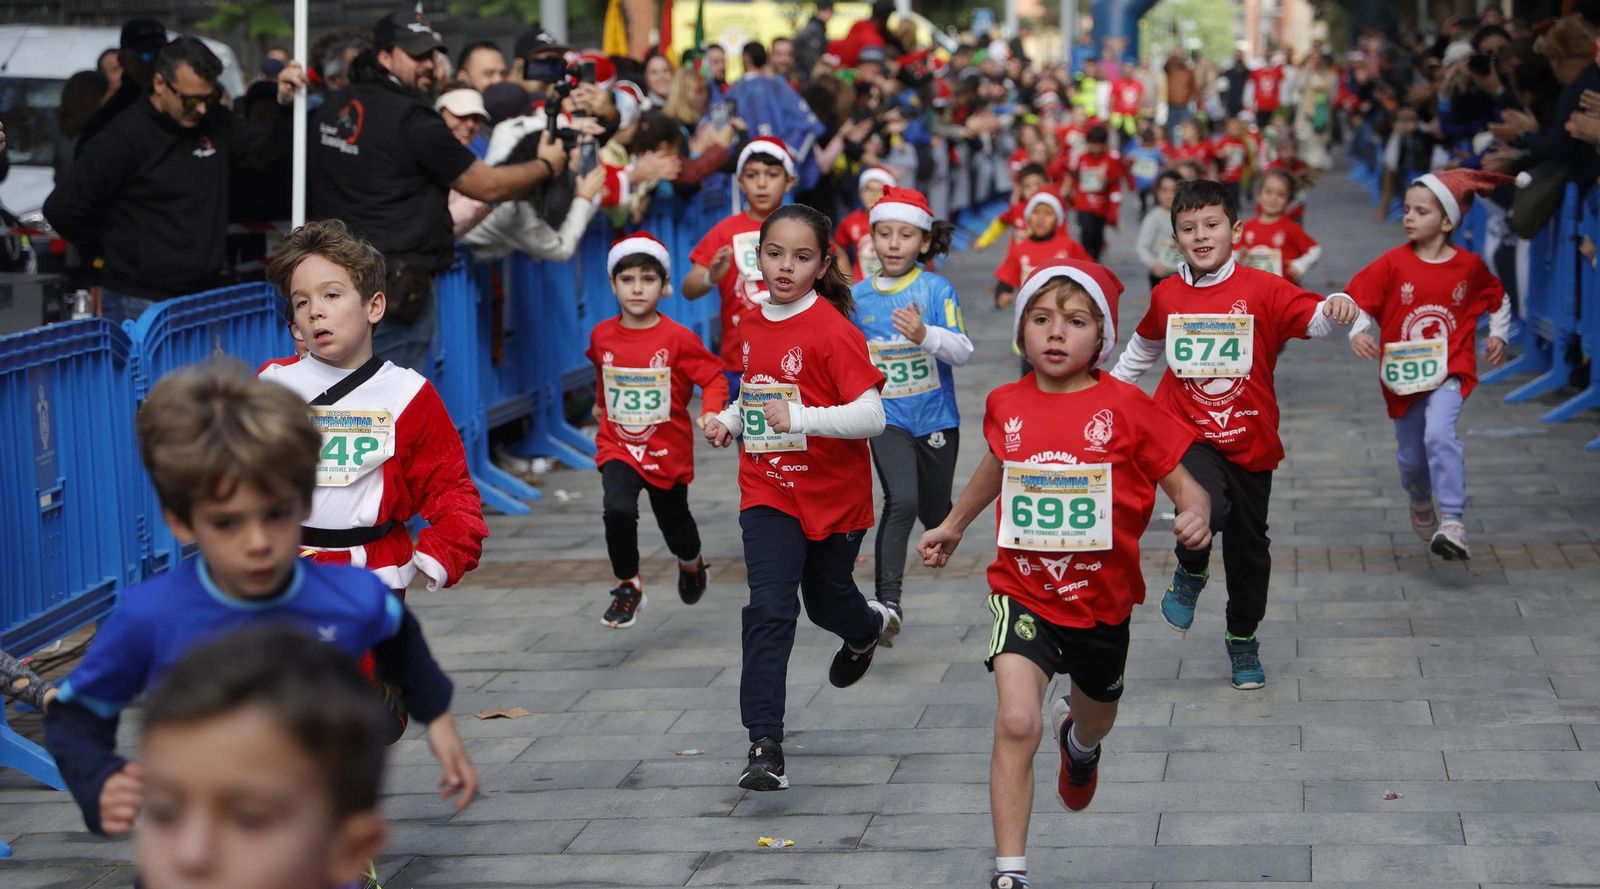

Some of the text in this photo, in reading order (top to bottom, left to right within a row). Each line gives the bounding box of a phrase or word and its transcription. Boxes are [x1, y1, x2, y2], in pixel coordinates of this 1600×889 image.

[1175, 337, 1240, 361] 674
[1386, 360, 1438, 382] 690
[609, 387, 661, 411] 733
[1192, 394, 1212, 406] CIUDAD
[1234, 410, 1259, 418] EVOS
[342, 416, 372, 428] NAVIDAD
[1204, 426, 1246, 438] CUPRA
[319, 436, 379, 466] 48
[1020, 474, 1052, 488] CARRERA
[1055, 476, 1089, 488] NAVIDAD
[1012, 494, 1096, 529] 698
[1043, 580, 1089, 595] CPRA
